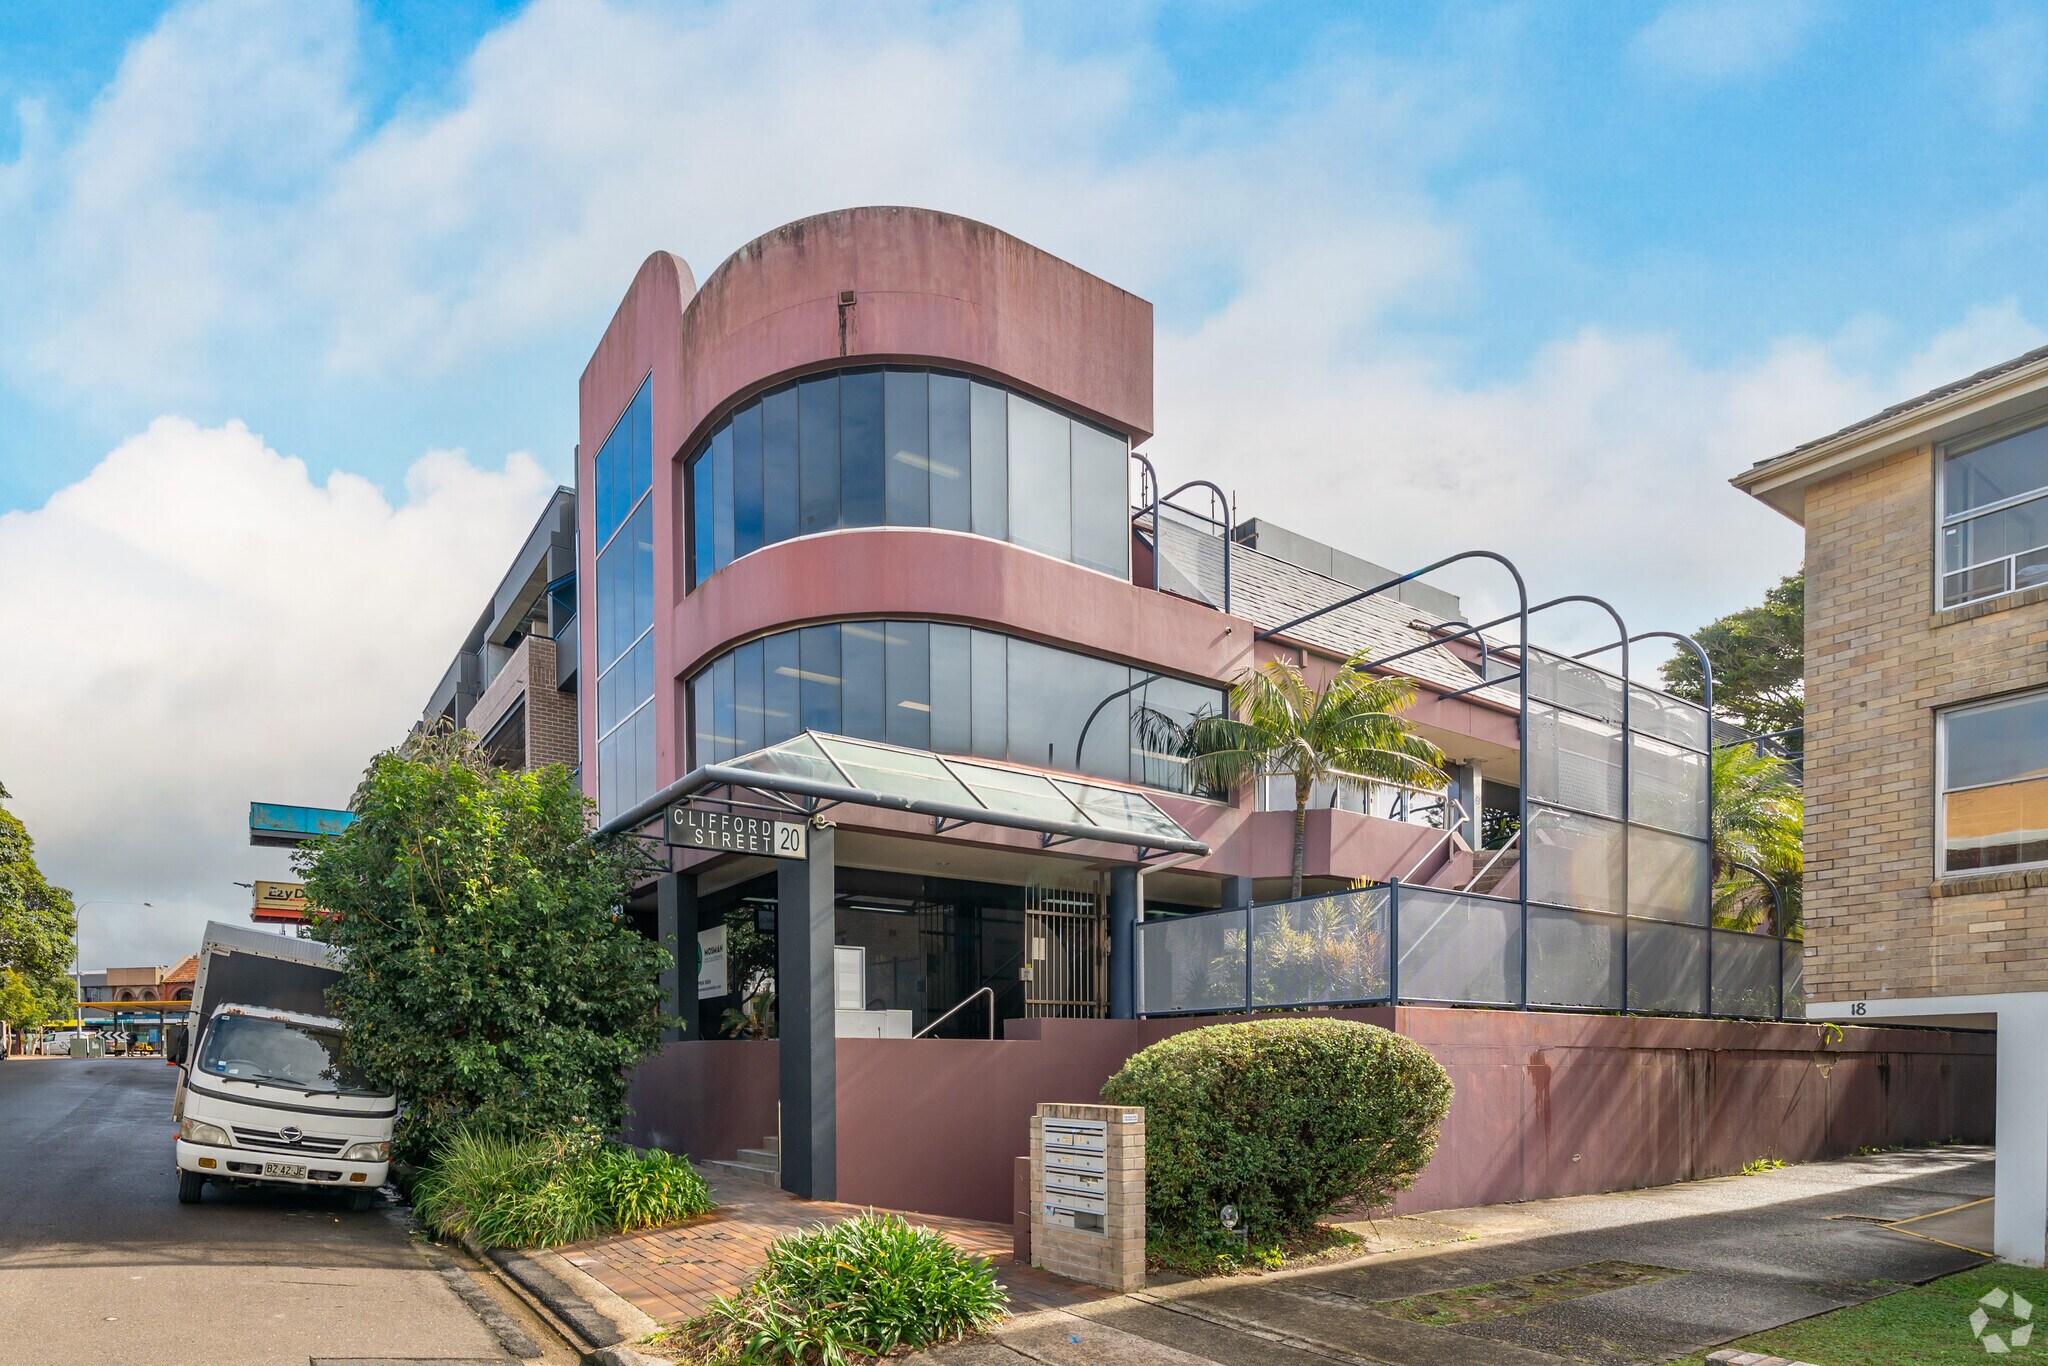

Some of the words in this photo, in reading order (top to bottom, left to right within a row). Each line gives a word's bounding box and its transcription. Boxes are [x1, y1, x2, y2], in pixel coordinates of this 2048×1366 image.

[674, 809, 771, 836] CLIFFORD
[694, 828, 771, 852] STREET
[780, 827, 800, 852] 20
[704, 943, 723, 956] MOSMAN
[1851, 1002, 1867, 1016] 18
